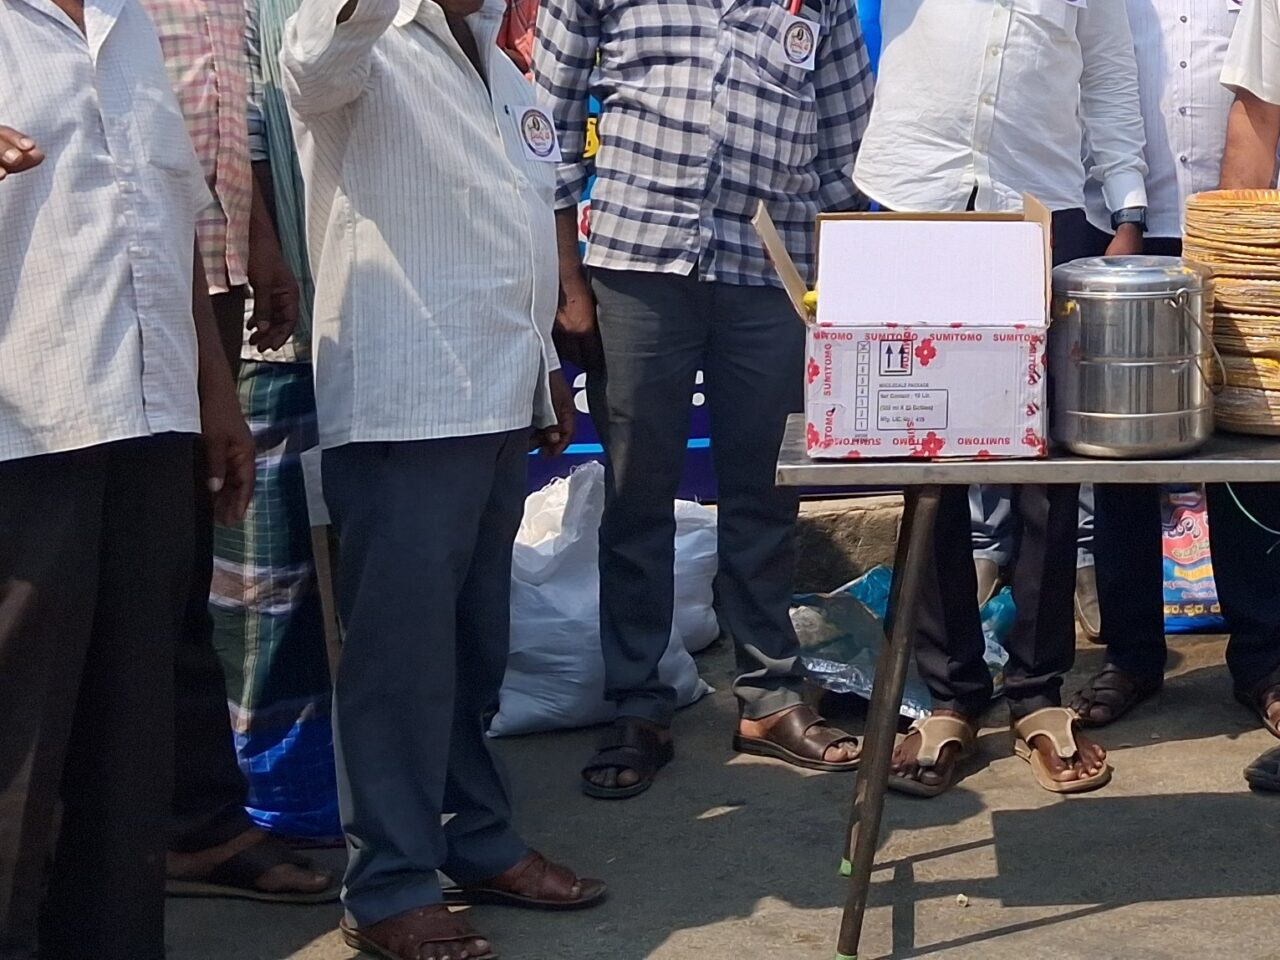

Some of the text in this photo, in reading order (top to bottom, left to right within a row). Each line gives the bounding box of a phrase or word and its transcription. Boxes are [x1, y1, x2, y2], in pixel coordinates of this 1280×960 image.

[929, 333, 982, 341] SUMITOMO
[824, 343, 833, 396] SUMITOMO
[957, 437, 1010, 446] SUMITOMO
